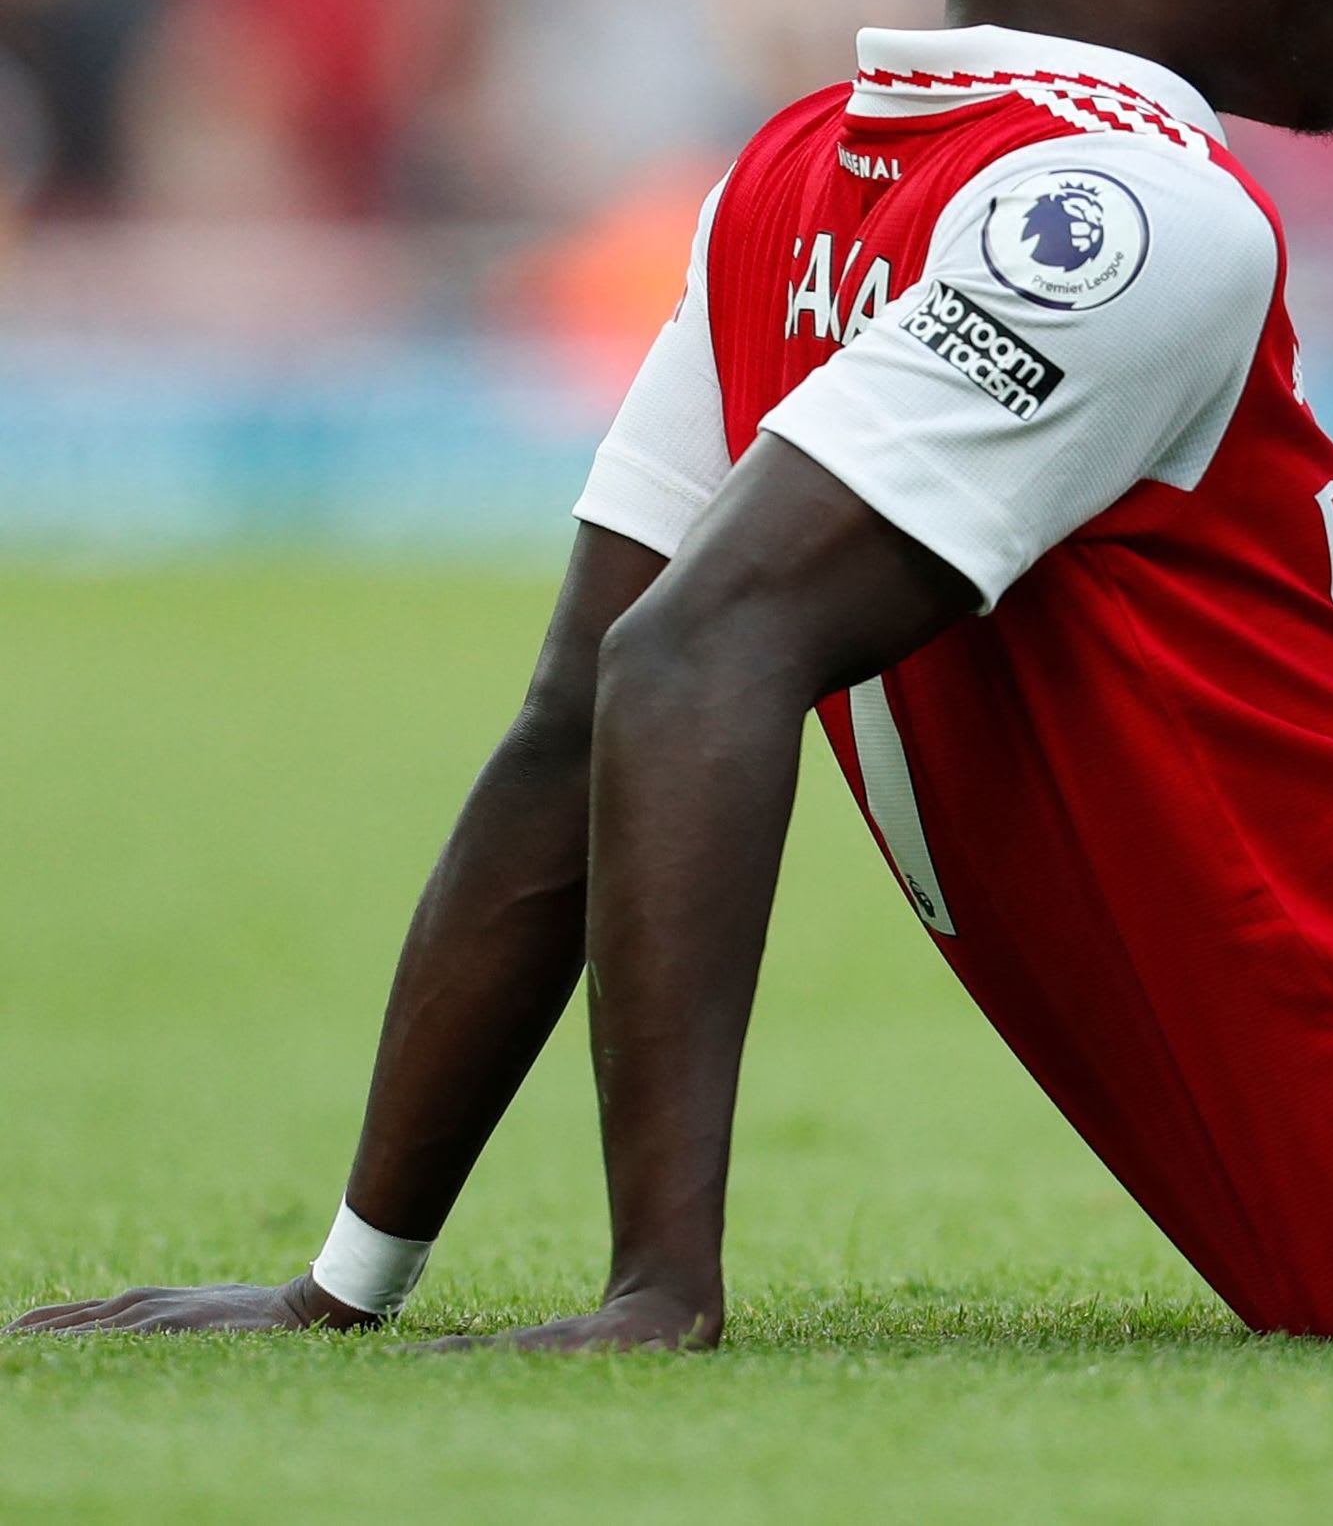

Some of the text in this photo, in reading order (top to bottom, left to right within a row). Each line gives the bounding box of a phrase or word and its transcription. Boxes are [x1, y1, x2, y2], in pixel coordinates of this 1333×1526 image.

[1031, 250, 1126, 295] Premier League
[923, 280, 1046, 389] No room
[936, 331, 1040, 420] racism
